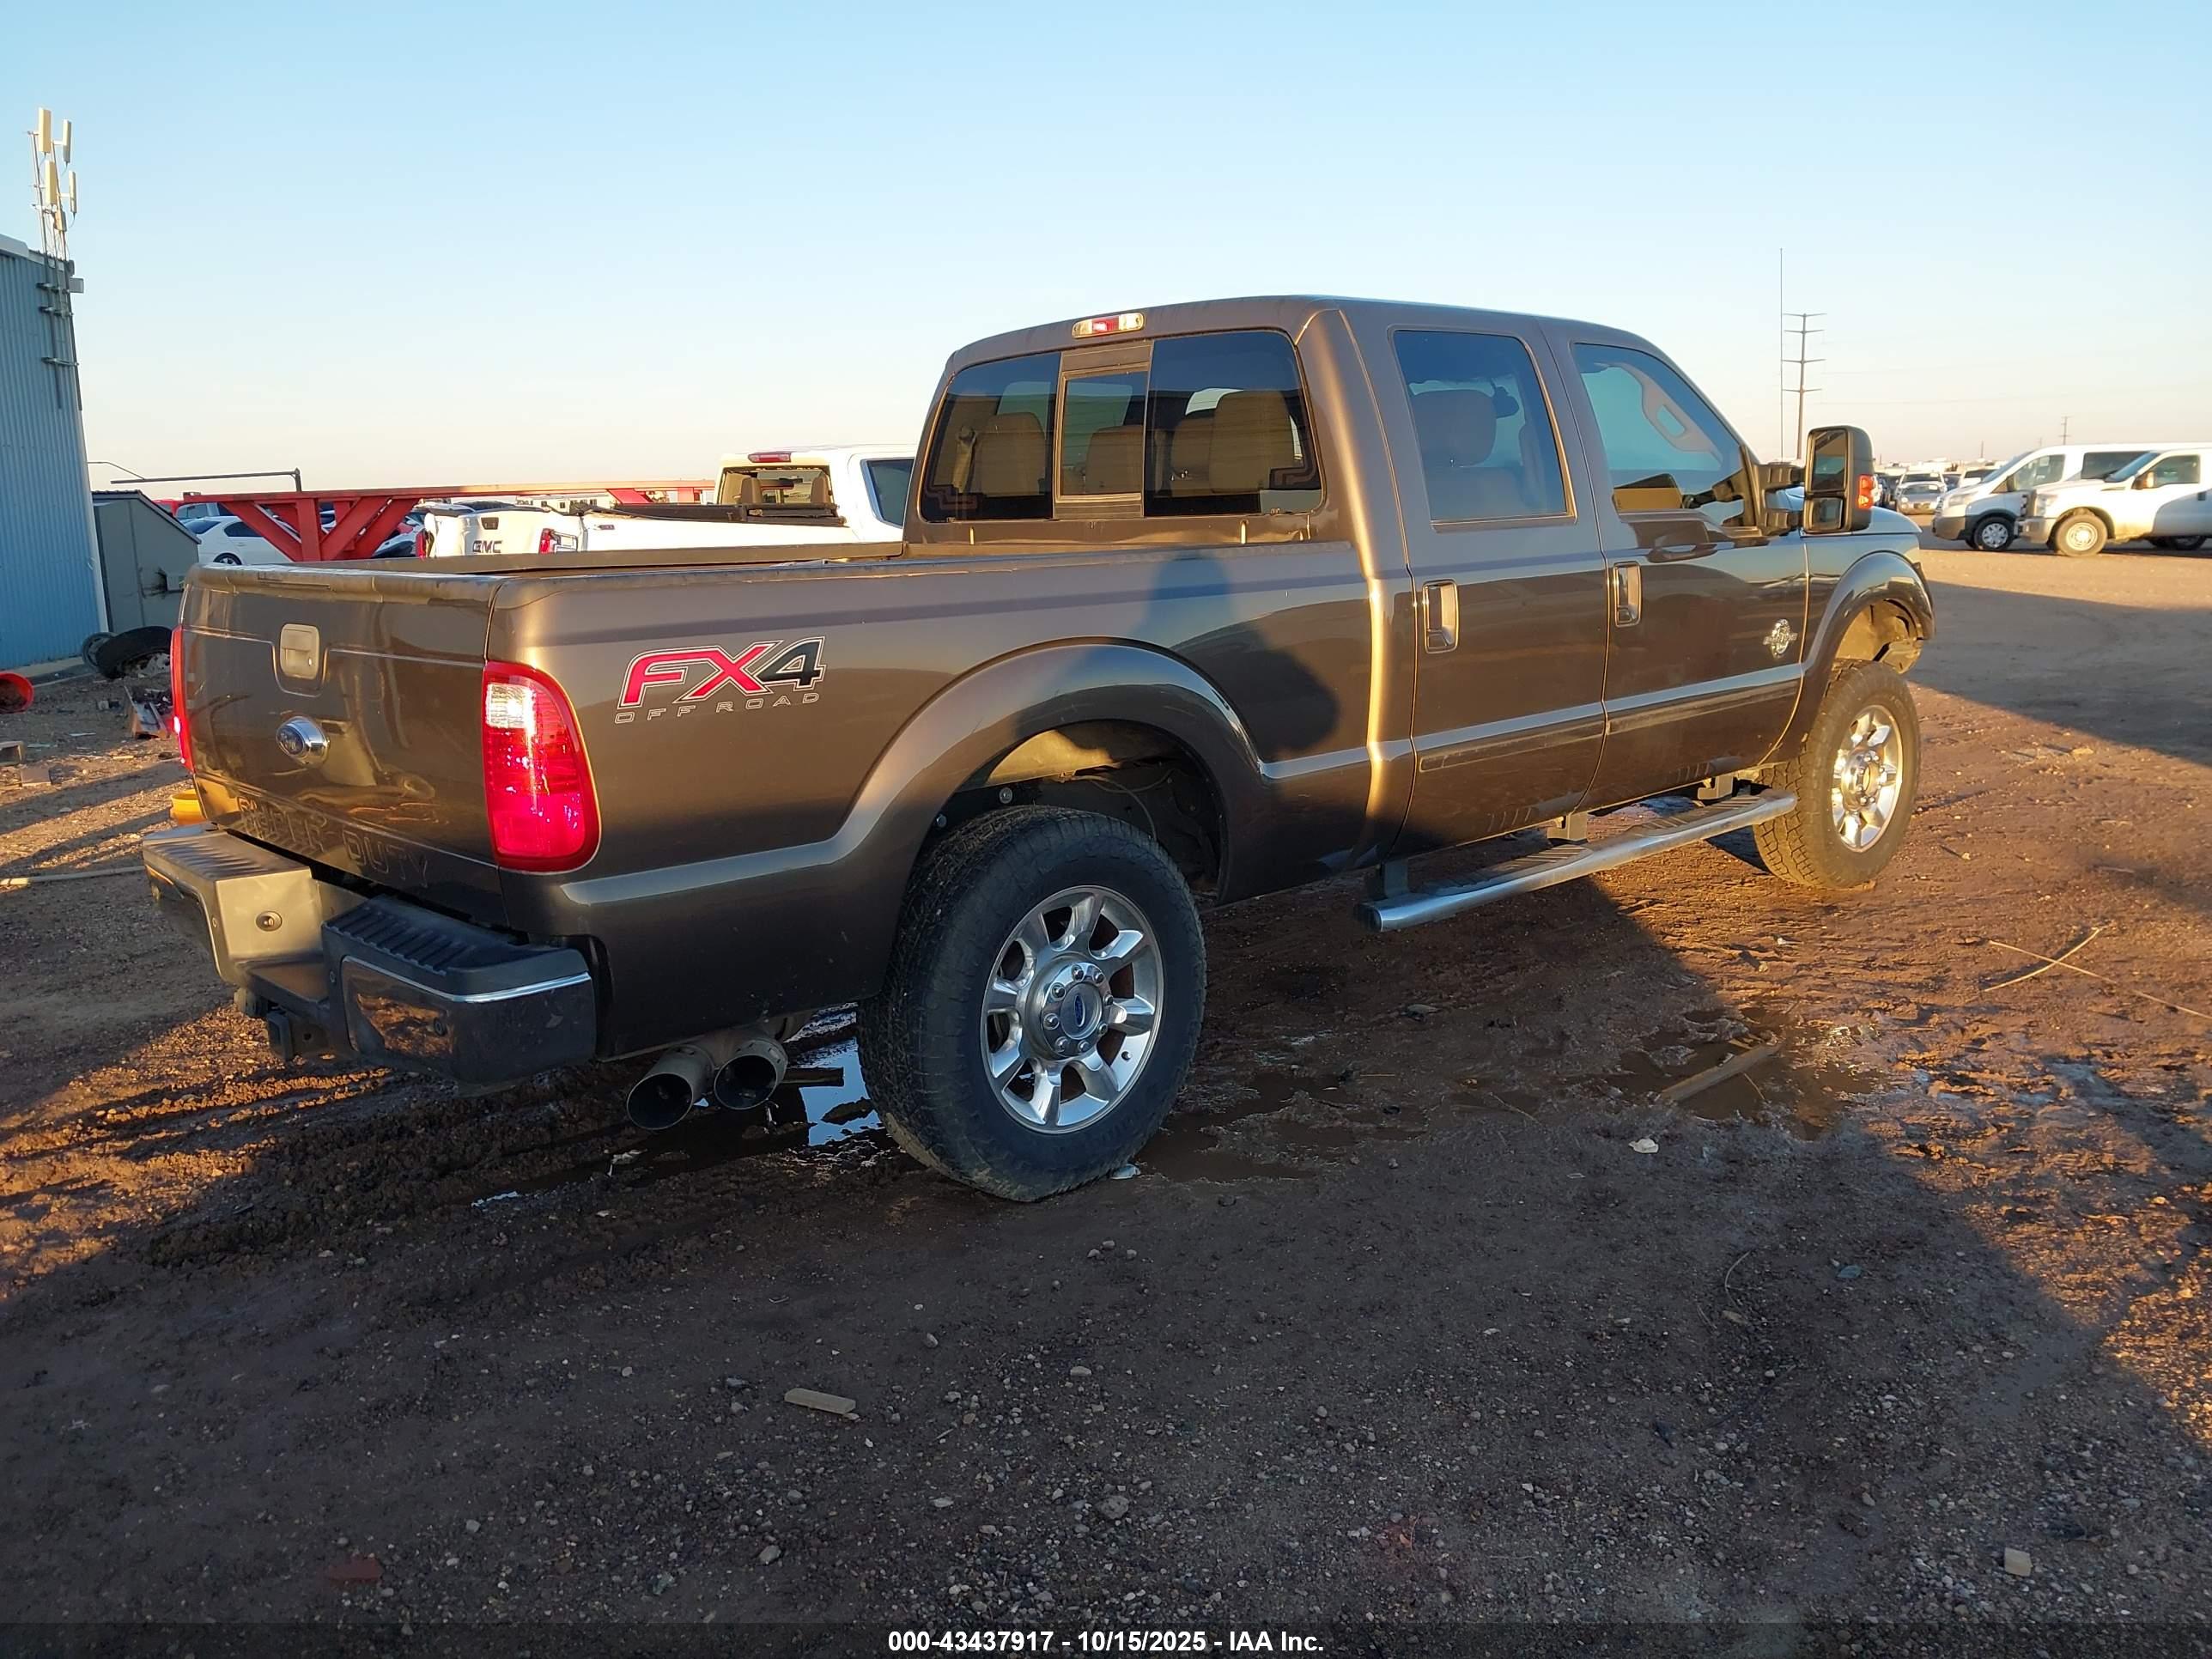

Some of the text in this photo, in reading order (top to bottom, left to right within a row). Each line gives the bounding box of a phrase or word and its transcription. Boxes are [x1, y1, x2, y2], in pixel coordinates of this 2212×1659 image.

[472, 540, 502, 553] GMC
[617, 636, 826, 709] FX4
[614, 692, 820, 724] OFF ROAD
[342, 828, 428, 889] DUTY
